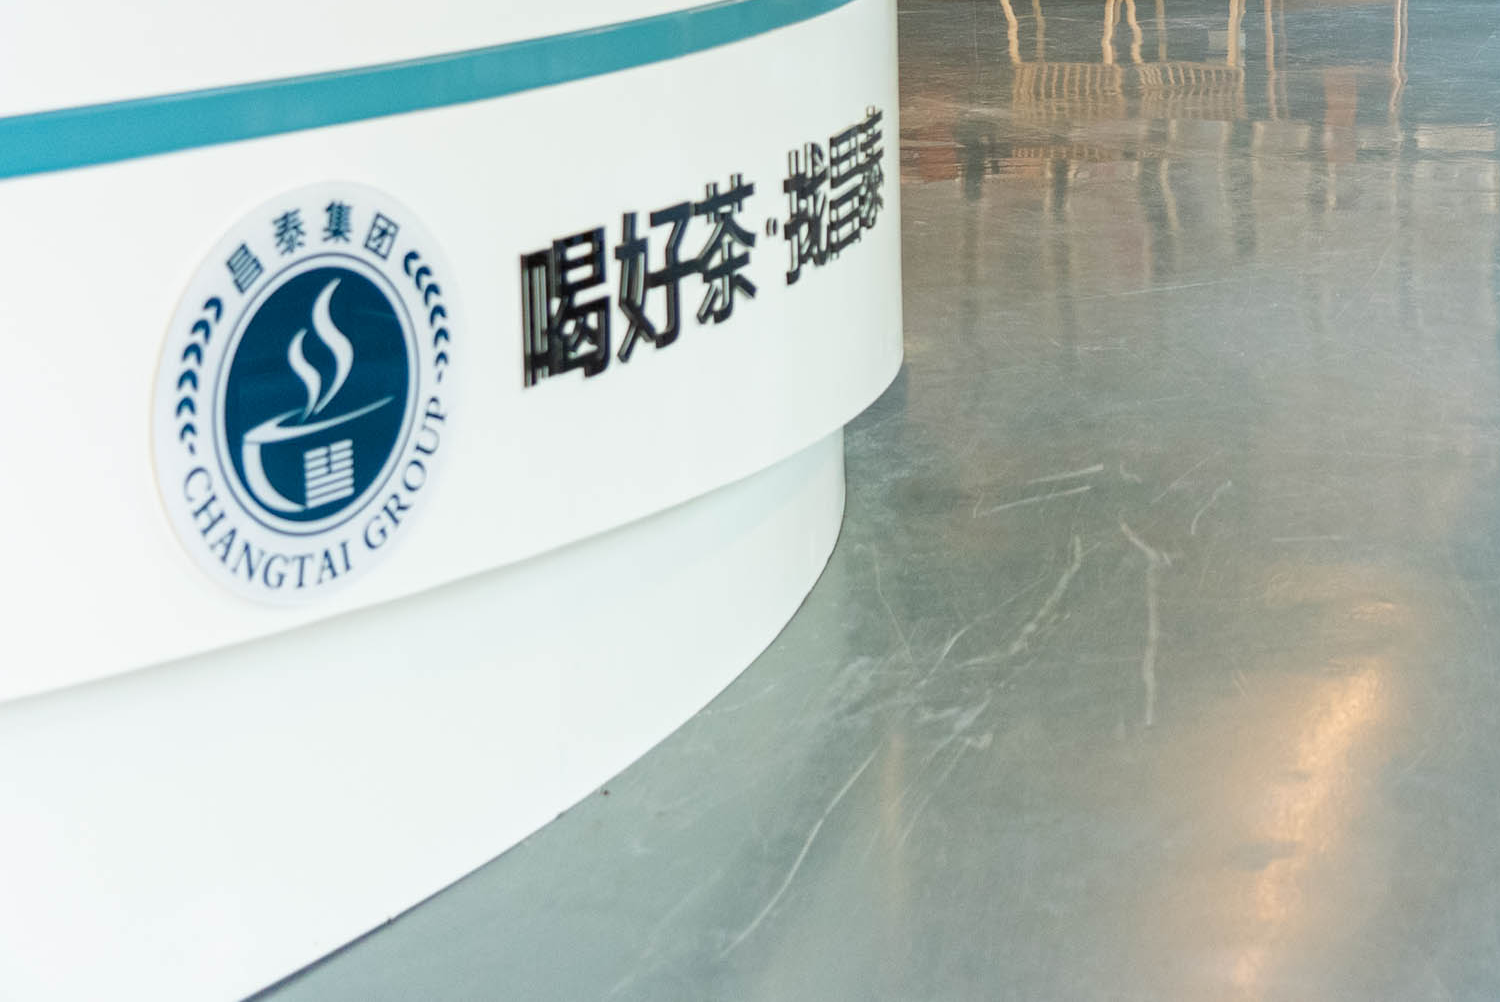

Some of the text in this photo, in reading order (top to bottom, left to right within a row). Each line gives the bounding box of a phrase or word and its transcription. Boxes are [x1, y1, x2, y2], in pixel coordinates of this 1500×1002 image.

[226, 200, 399, 295] 昌泰集团
[183, 395, 448, 590] CHANGTAI GROUP
